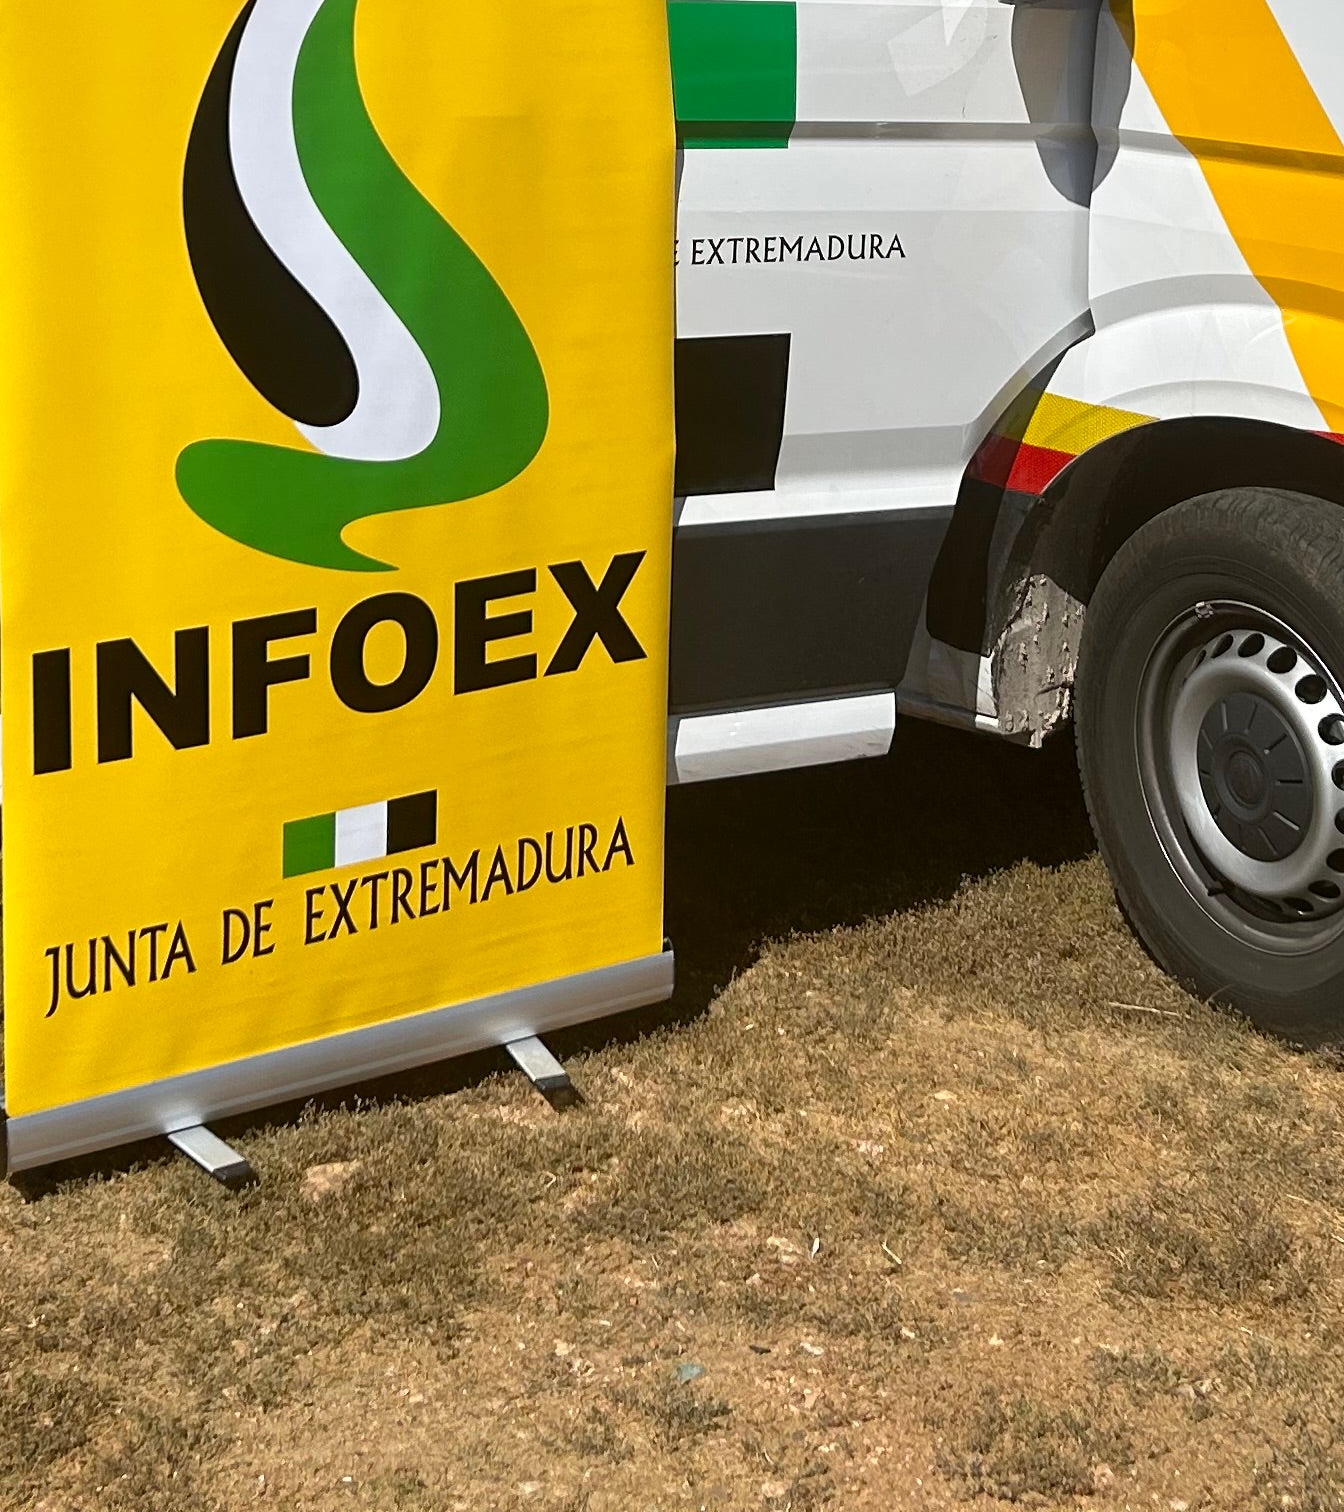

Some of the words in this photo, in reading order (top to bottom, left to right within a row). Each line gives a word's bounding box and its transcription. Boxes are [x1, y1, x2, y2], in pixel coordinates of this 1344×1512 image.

[691, 233, 906, 266] EXTREMADURA
[32, 549, 648, 776] INFOEX
[45, 919, 196, 1018] JUNTA
[222, 899, 277, 965] DE
[304, 816, 636, 946] EXTREMADURA
